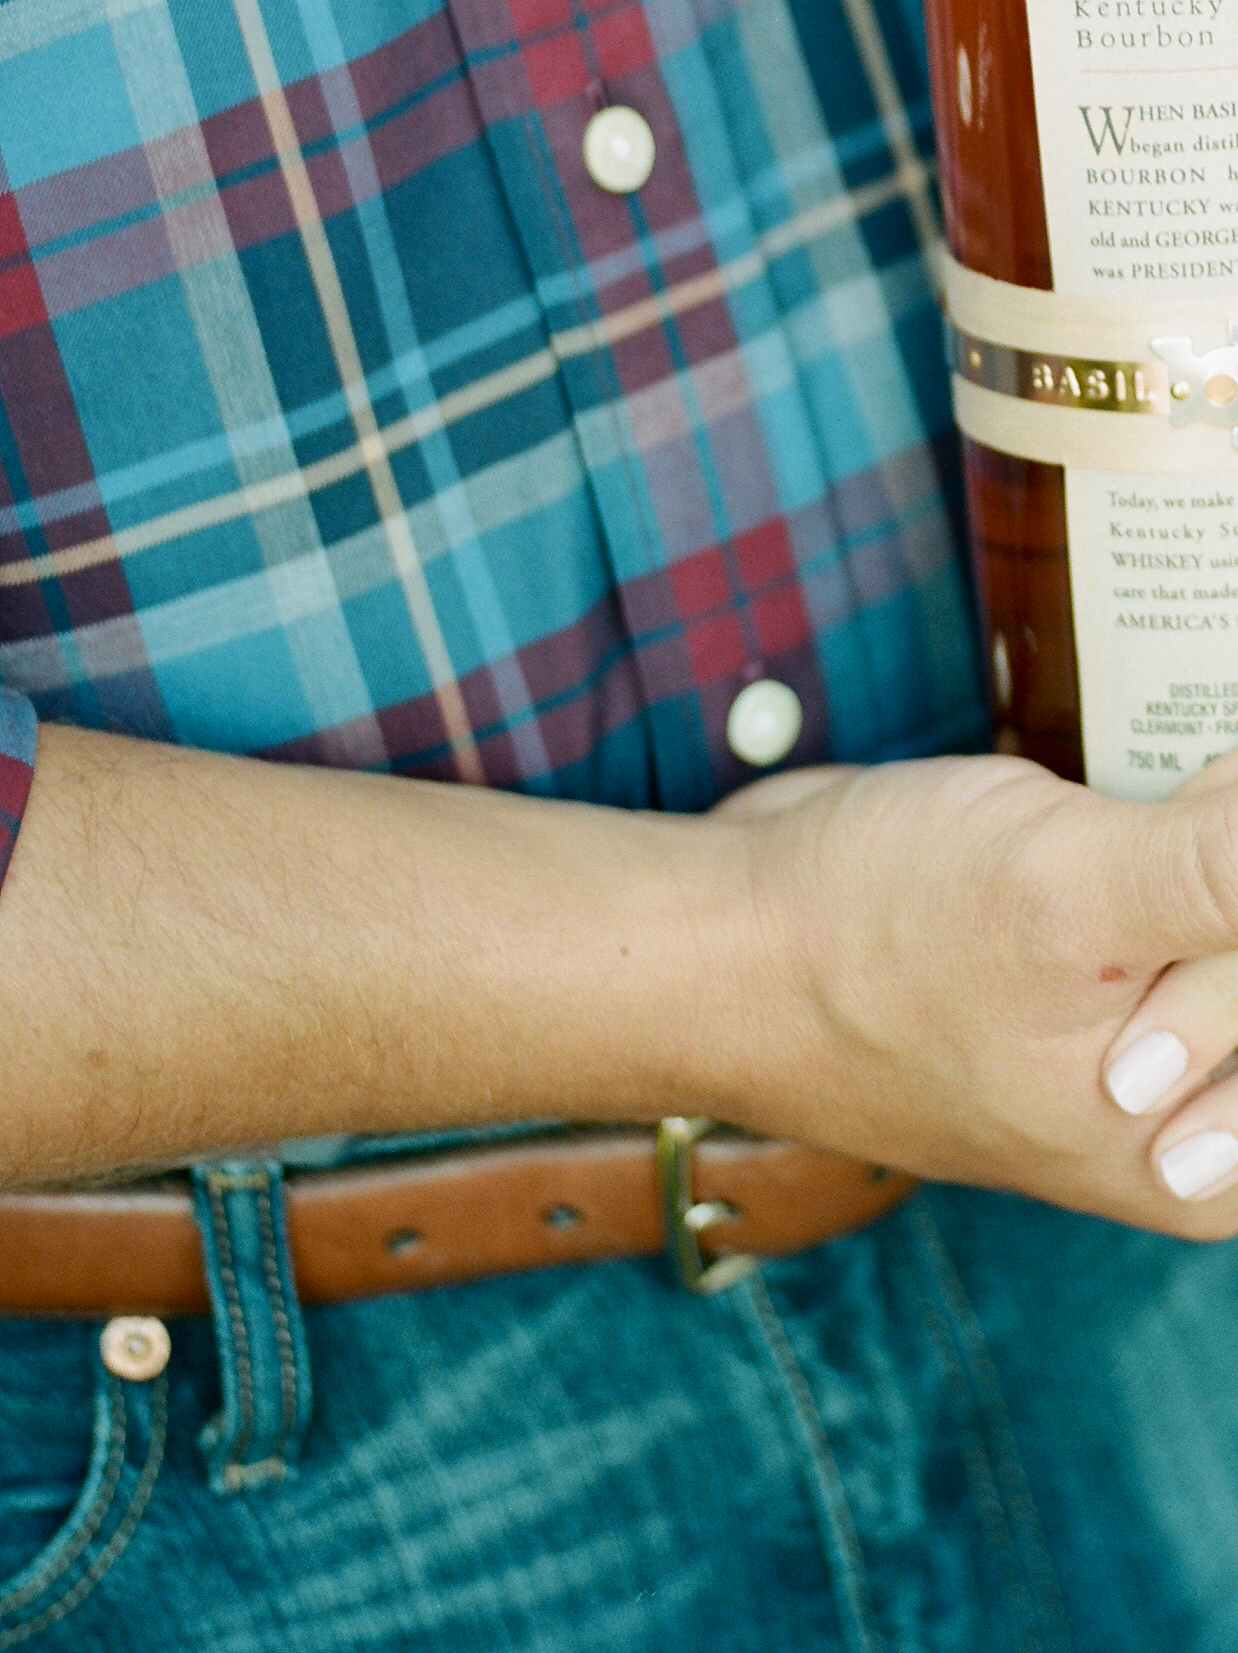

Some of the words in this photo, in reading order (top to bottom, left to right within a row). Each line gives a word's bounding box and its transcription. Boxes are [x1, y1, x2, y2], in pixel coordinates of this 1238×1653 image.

[1076, 24, 1215, 50] Bourbon
[1130, 136, 1184, 158] began
[1086, 166, 1207, 186] BOURBON
[1088, 198, 1211, 217] KENTUCKY
[1090, 230, 1115, 248] old
[1120, 230, 1150, 248] and
[1092, 264, 1124, 280] was
[1032, 363, 1158, 403] BASIL
[1107, 489, 1159, 514] Today,
[1163, 497, 1186, 509] we
[1190, 490, 1235, 508] make
[1109, 520, 1206, 544] Kentucky
[1110, 550, 1203, 570] WHISKEY
[1112, 586, 1147, 600] care
[1151, 582, 1187, 600] that
[1115, 611, 1231, 631] AMERICA'S
[1146, 701, 1218, 717] KENTUCKY
